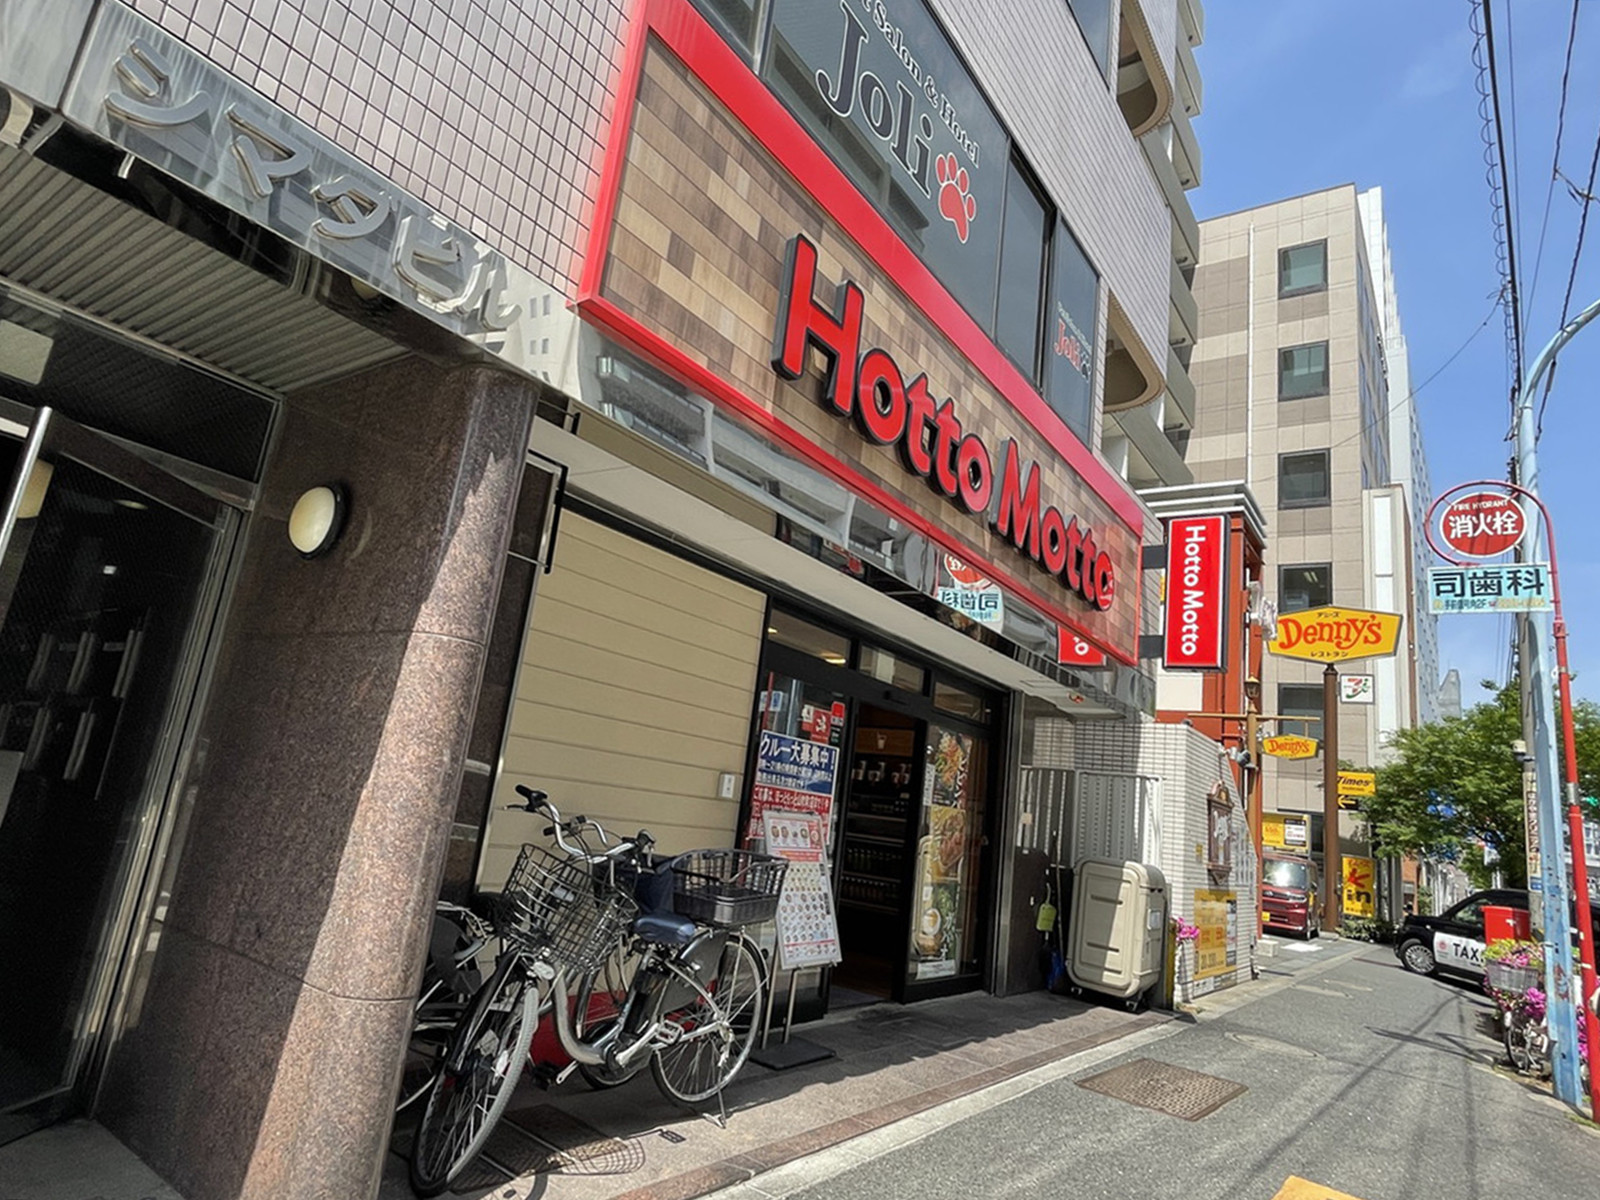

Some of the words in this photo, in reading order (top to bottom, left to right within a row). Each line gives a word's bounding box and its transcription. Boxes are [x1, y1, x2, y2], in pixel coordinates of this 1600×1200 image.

[816, 0, 931, 199] Joli
[873, 0, 922, 87] Salon
[923, 75, 939, 109] &
[939, 93, 981, 169] Hotel
[771, 233, 993, 515] Hotto
[988, 436, 1115, 612] Motto
[1453, 503, 1470, 512] FIRE
[1472, 500, 1508, 510] HYDRANT
[1448, 510, 1519, 539] 消火栓
[1183, 525, 1206, 587] Hotto
[1432, 568, 1544, 597] 司歯科
[1181, 590, 1204, 656] Motto
[1278, 614, 1382, 650] Denny's
[1268, 739, 1310, 755] Denny's
[1453, 943, 1484, 962] TAX
